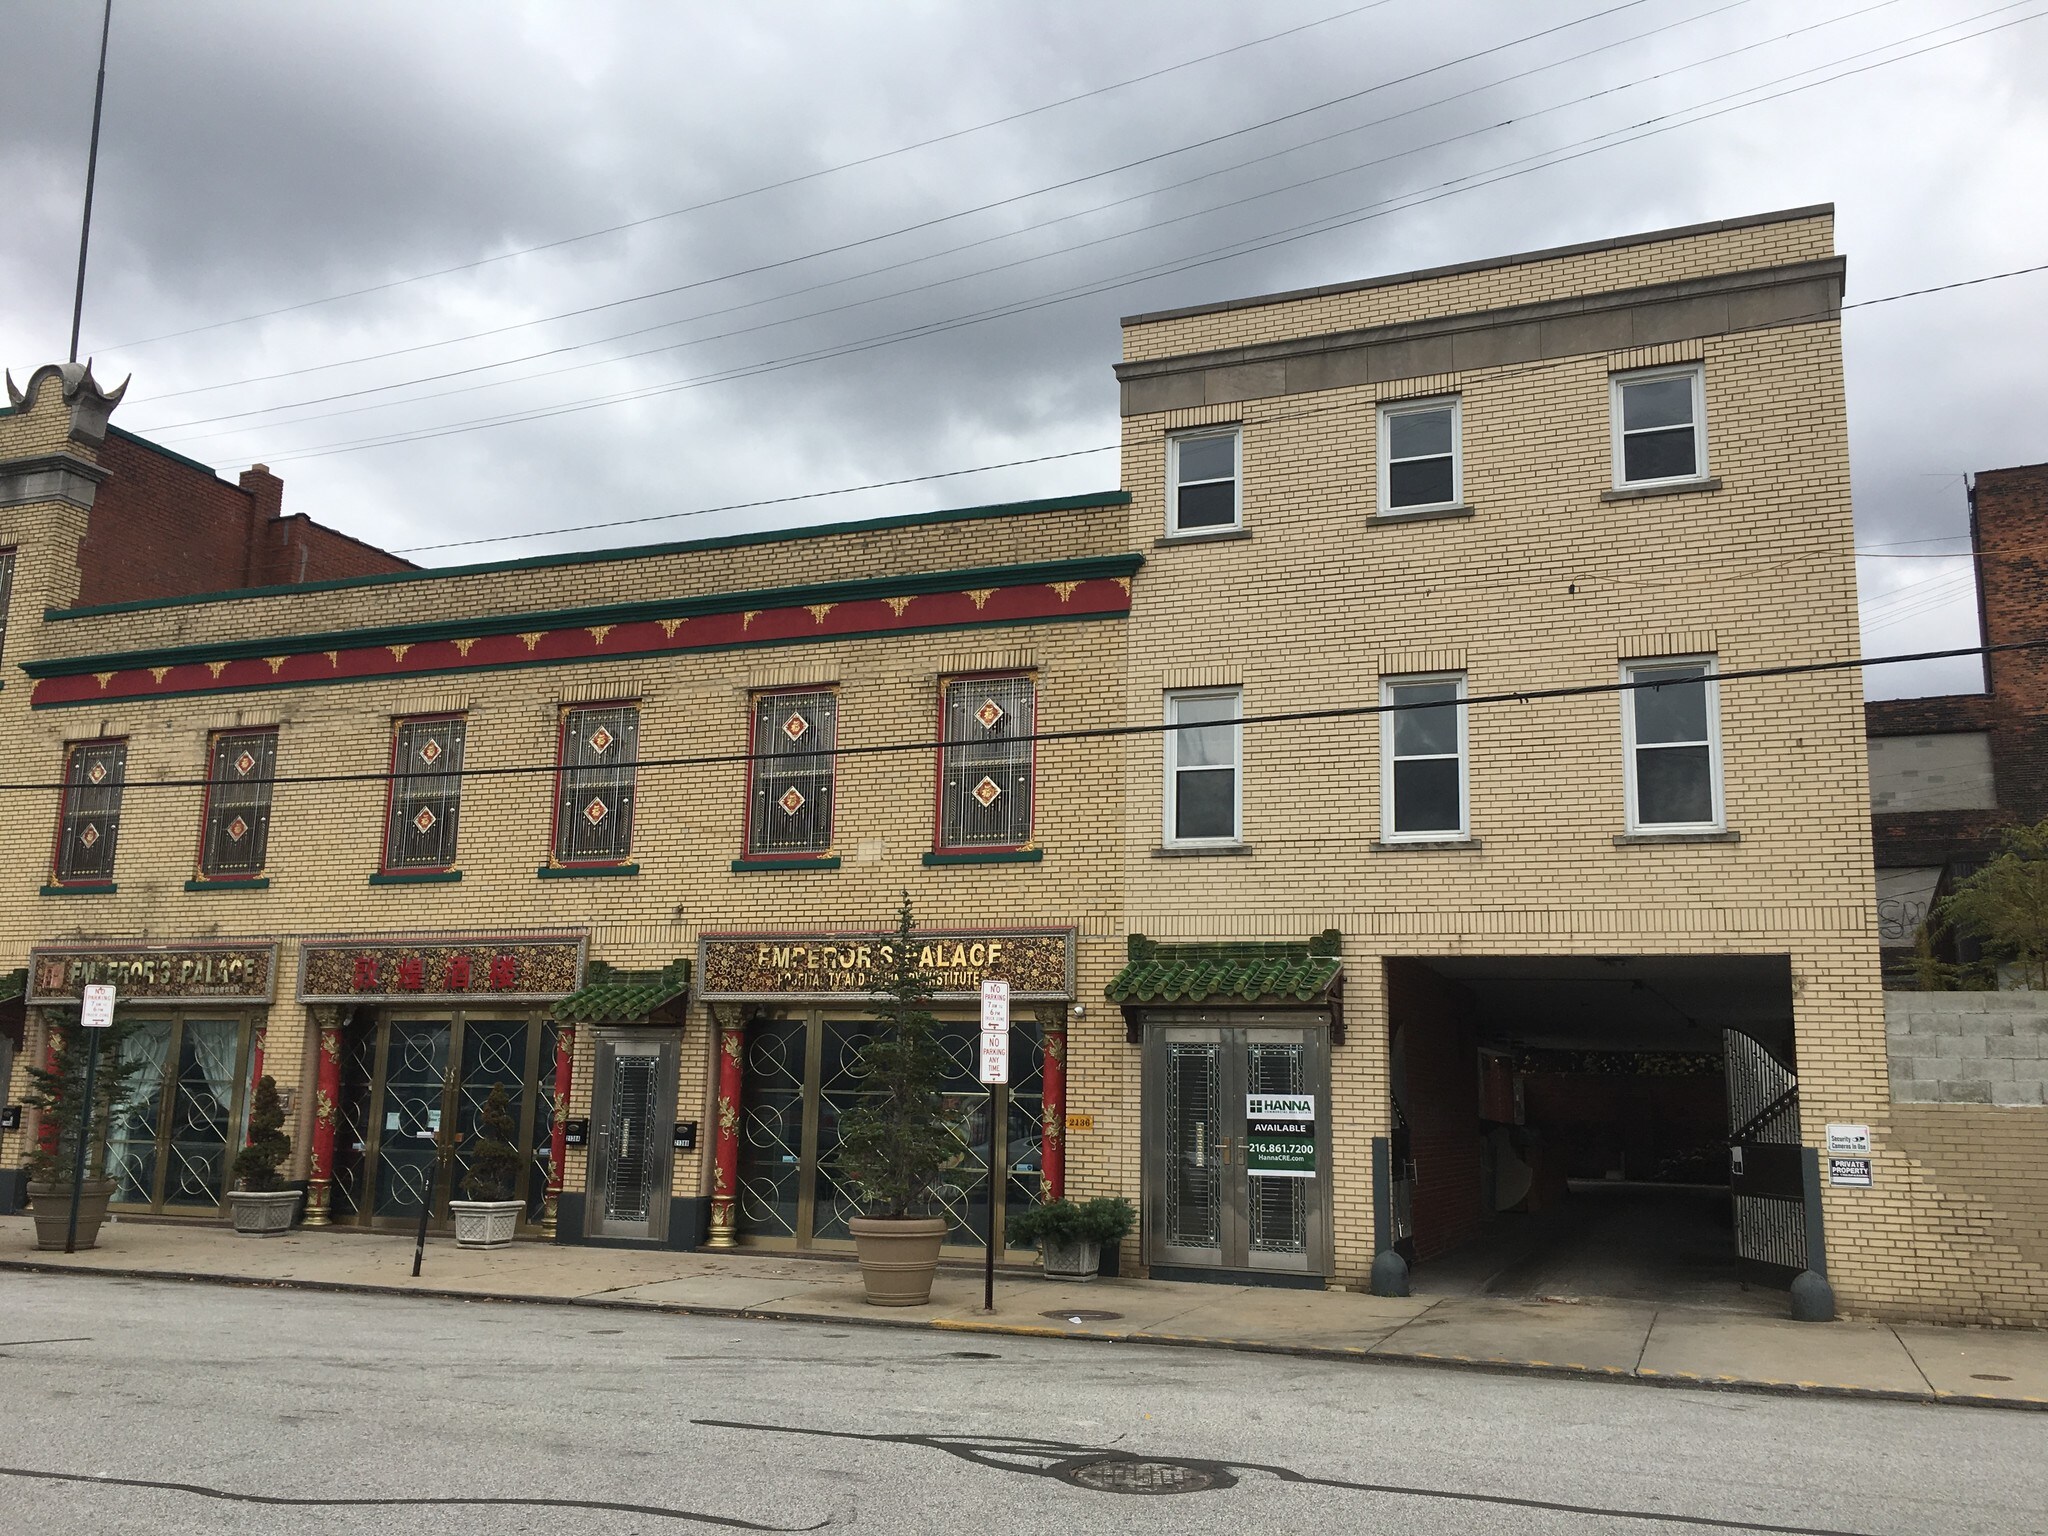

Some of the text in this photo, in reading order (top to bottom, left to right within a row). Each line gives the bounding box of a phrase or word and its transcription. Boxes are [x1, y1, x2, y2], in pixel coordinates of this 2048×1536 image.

[758, 946, 894, 968] EMPEROR'S
[70, 960, 171, 984] EMEROR'S
[777, 971, 840, 987] HOSPITATY
[990, 984, 1001, 994] NO
[984, 994, 1006, 1002] PARKING
[989, 1038, 1000, 1047] NO
[983, 1048, 1006, 1056] PARKING
[1264, 1100, 1311, 1111] HANNA
[1069, 1118, 1091, 1127] 2136
[1254, 1124, 1306, 1132] AVAILABLE
[1831, 1135, 1851, 1143] Security
[1249, 1143, 1314, 1154] 216.861.7200
[1258, 1154, 1305, 1162] HannaCRE.com
